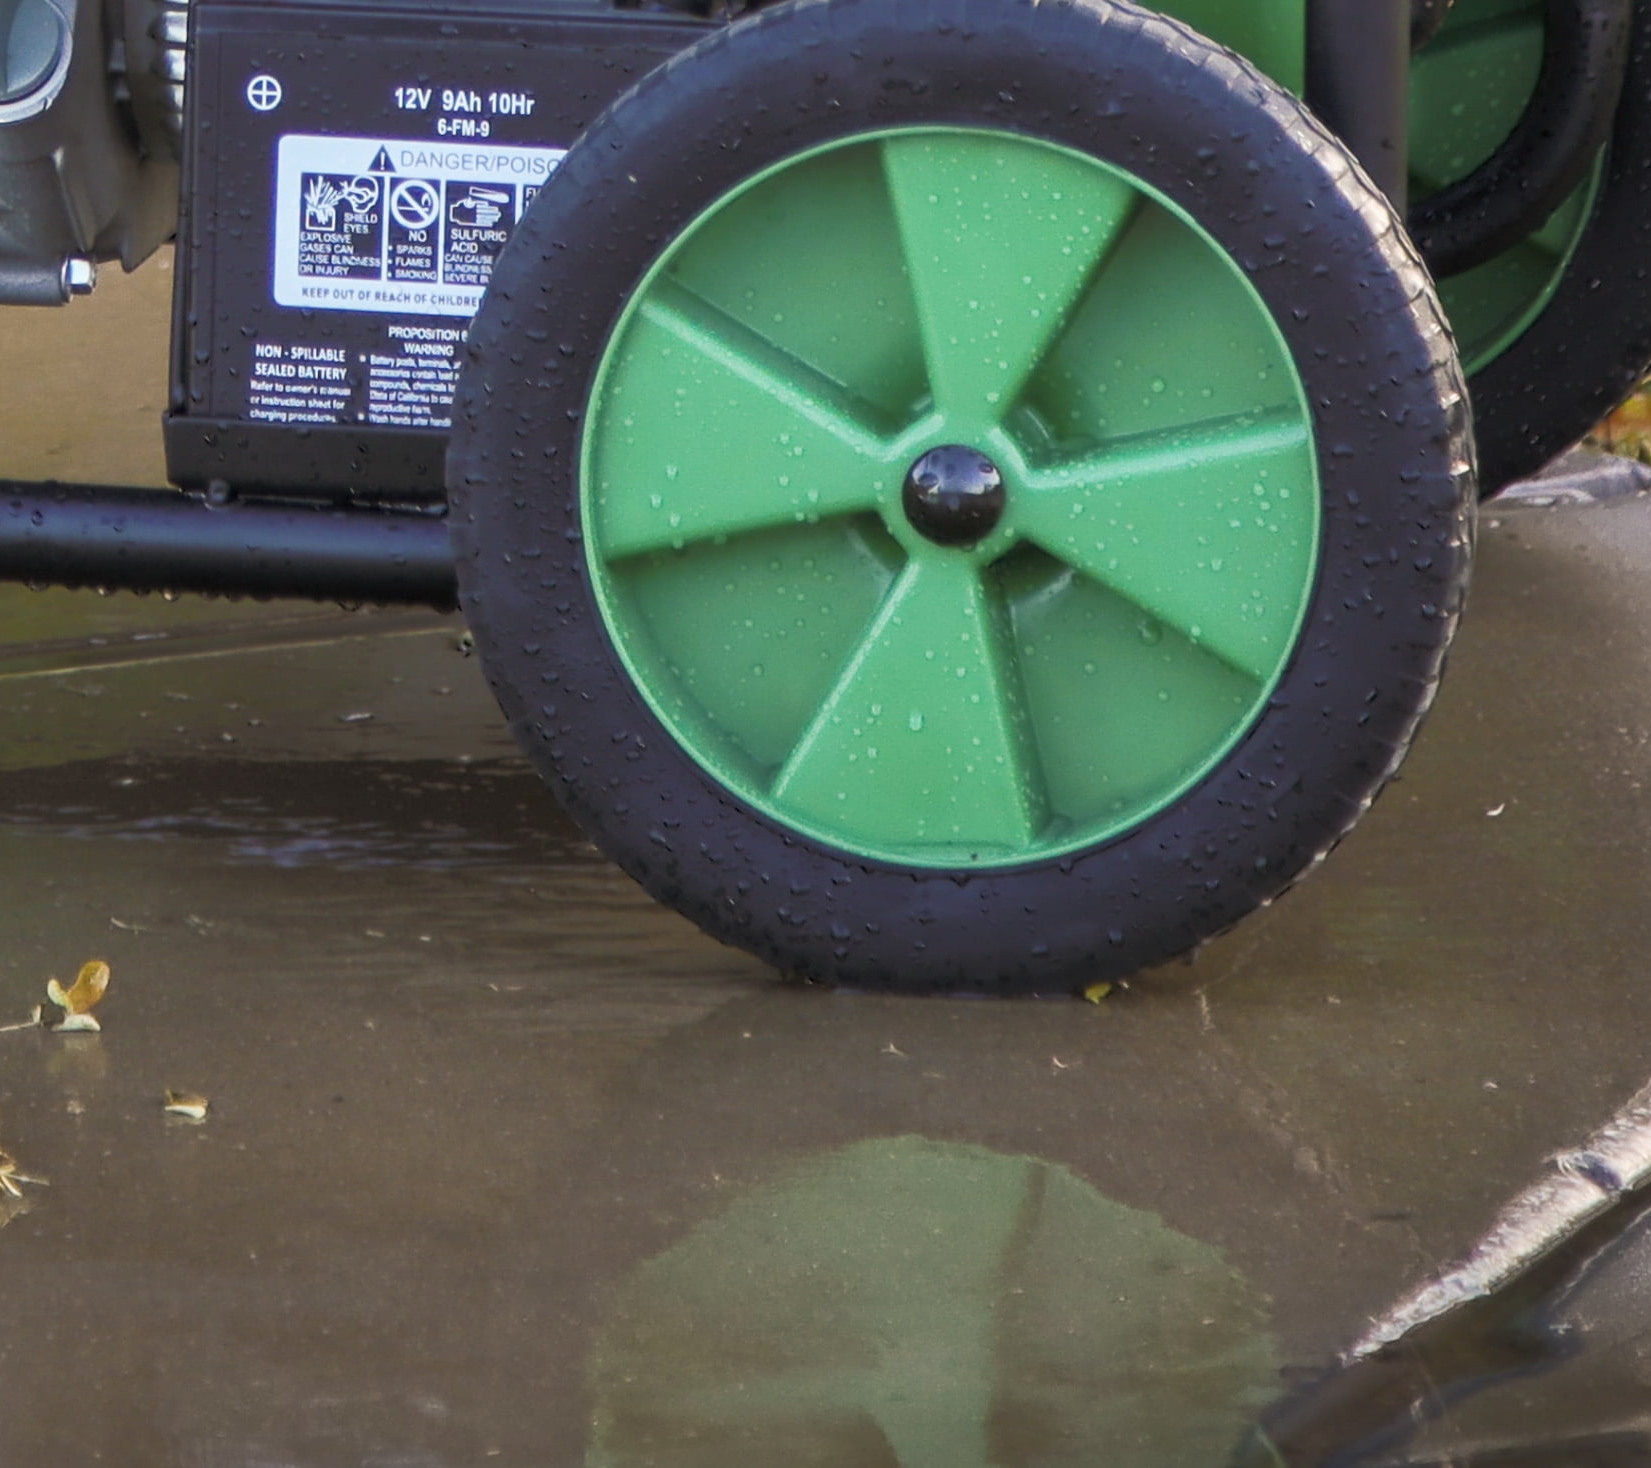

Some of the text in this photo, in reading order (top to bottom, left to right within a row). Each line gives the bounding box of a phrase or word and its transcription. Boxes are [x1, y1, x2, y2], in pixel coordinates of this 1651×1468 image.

[394, 87, 535, 115] 12V 9Ah 10Hr
[437, 118, 490, 137] 6-FM-9
[401, 150, 562, 174] DANGER/POISO
[408, 231, 427, 243] NO
[450, 229, 507, 243] SULFURIC
[451, 241, 479, 254] ACID
[302, 287, 483, 307] KEEP OUT OF REACH OF CHILDRE
[388, 326, 459, 342] PROPOSITION
[256, 344, 282, 358] NON
[290, 347, 345, 363] SPILLABLE
[404, 342, 454, 356] WARNING
[255, 363, 347, 381] SEALED BATTERY
